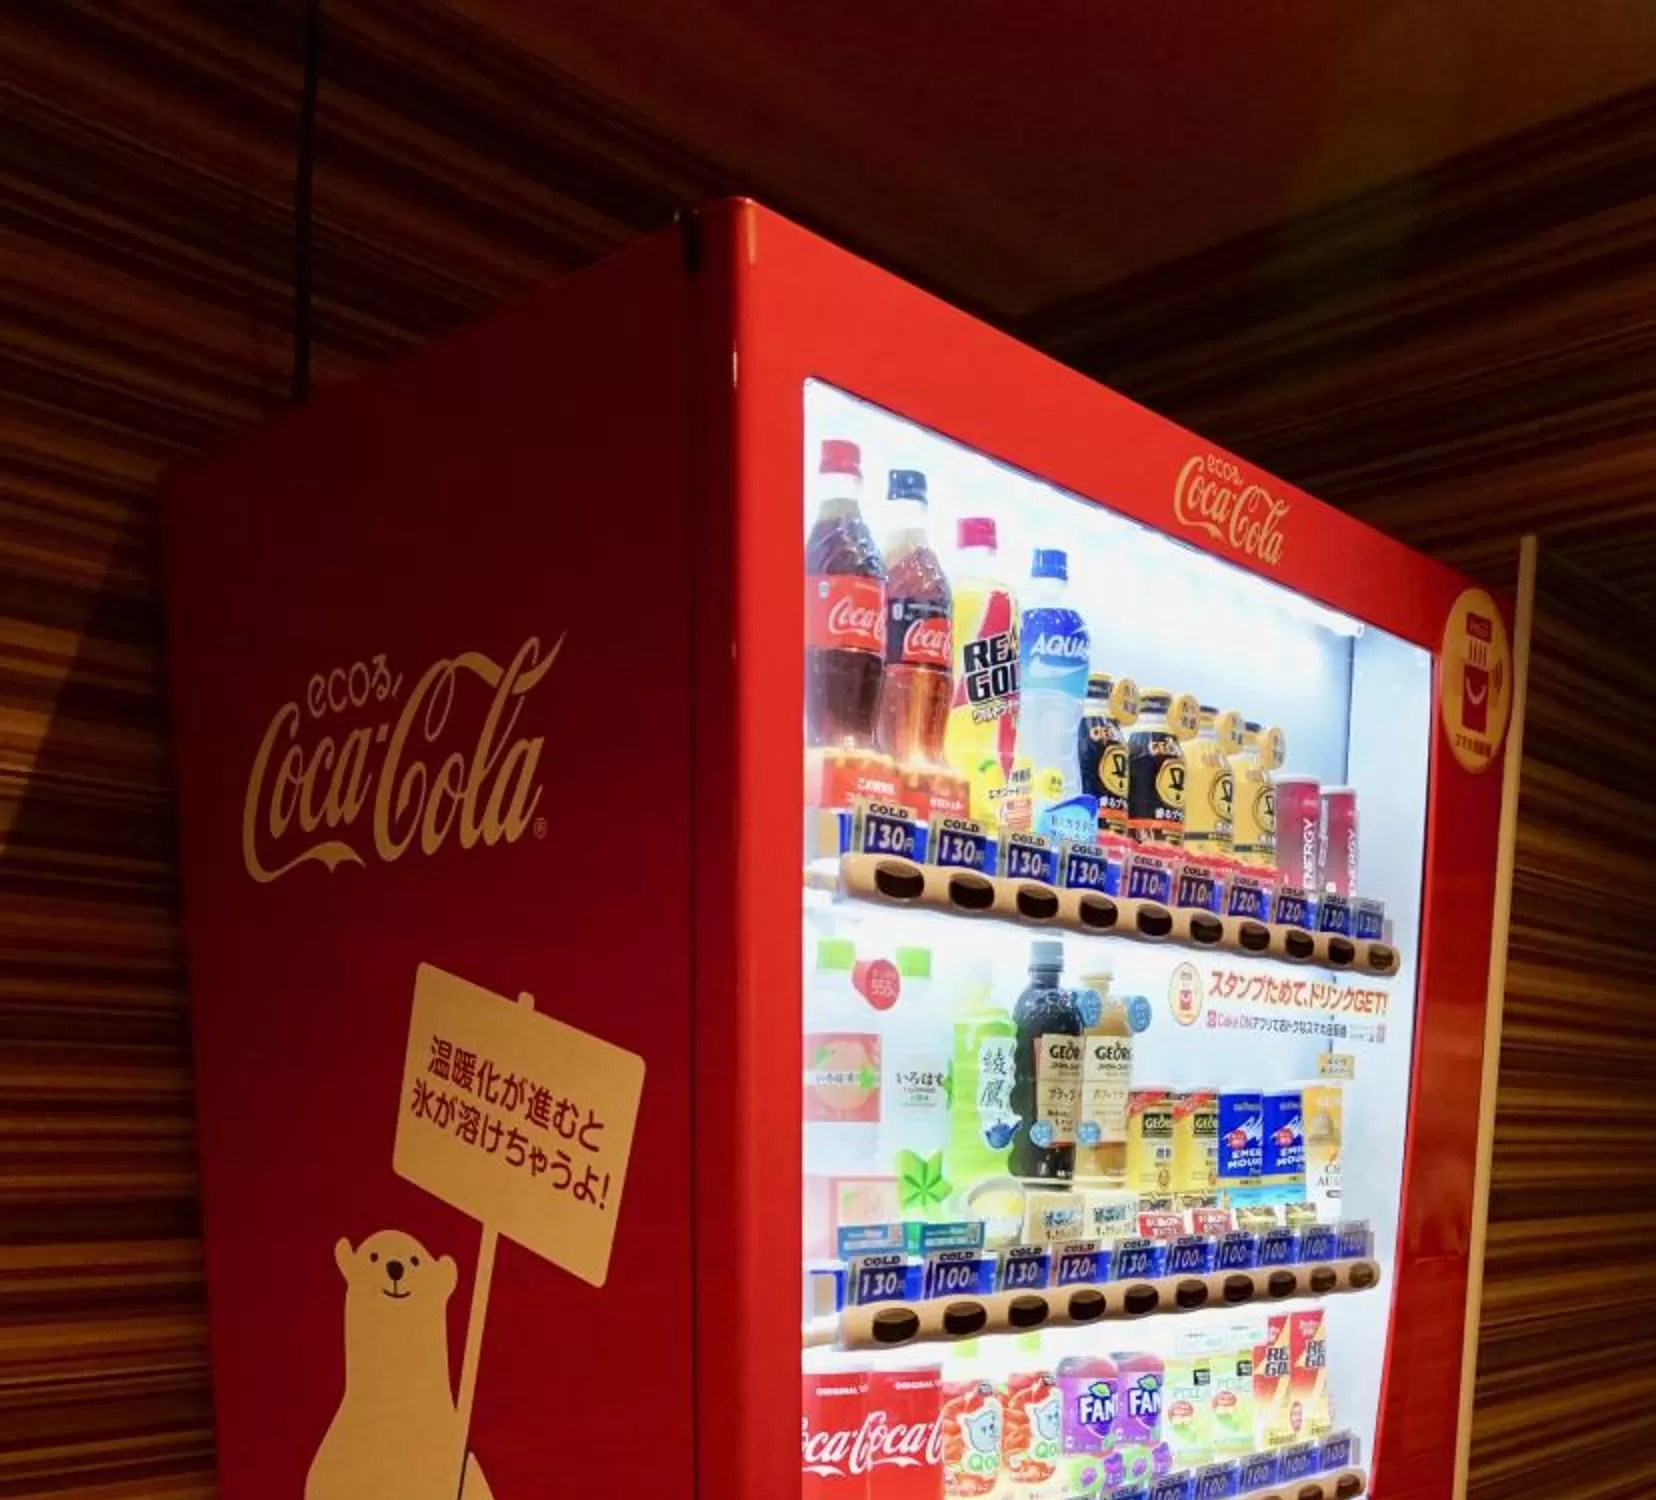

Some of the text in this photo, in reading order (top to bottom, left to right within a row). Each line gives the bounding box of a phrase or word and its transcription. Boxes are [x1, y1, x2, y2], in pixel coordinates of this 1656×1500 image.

[1174, 455, 1290, 566] Coca-Cola
[243, 630, 567, 883] Coca-Cola
[869, 803, 909, 819] COLD
[943, 818, 980, 833] COLD
[1012, 833, 1045, 847] COLD
[428, 1034, 605, 1153] 温暖化が進むと
[411, 1077, 611, 1211] 氷が溶けちゃうよ!
[863, 1255, 901, 1267] COLD
[939, 1250, 974, 1261] COLD
